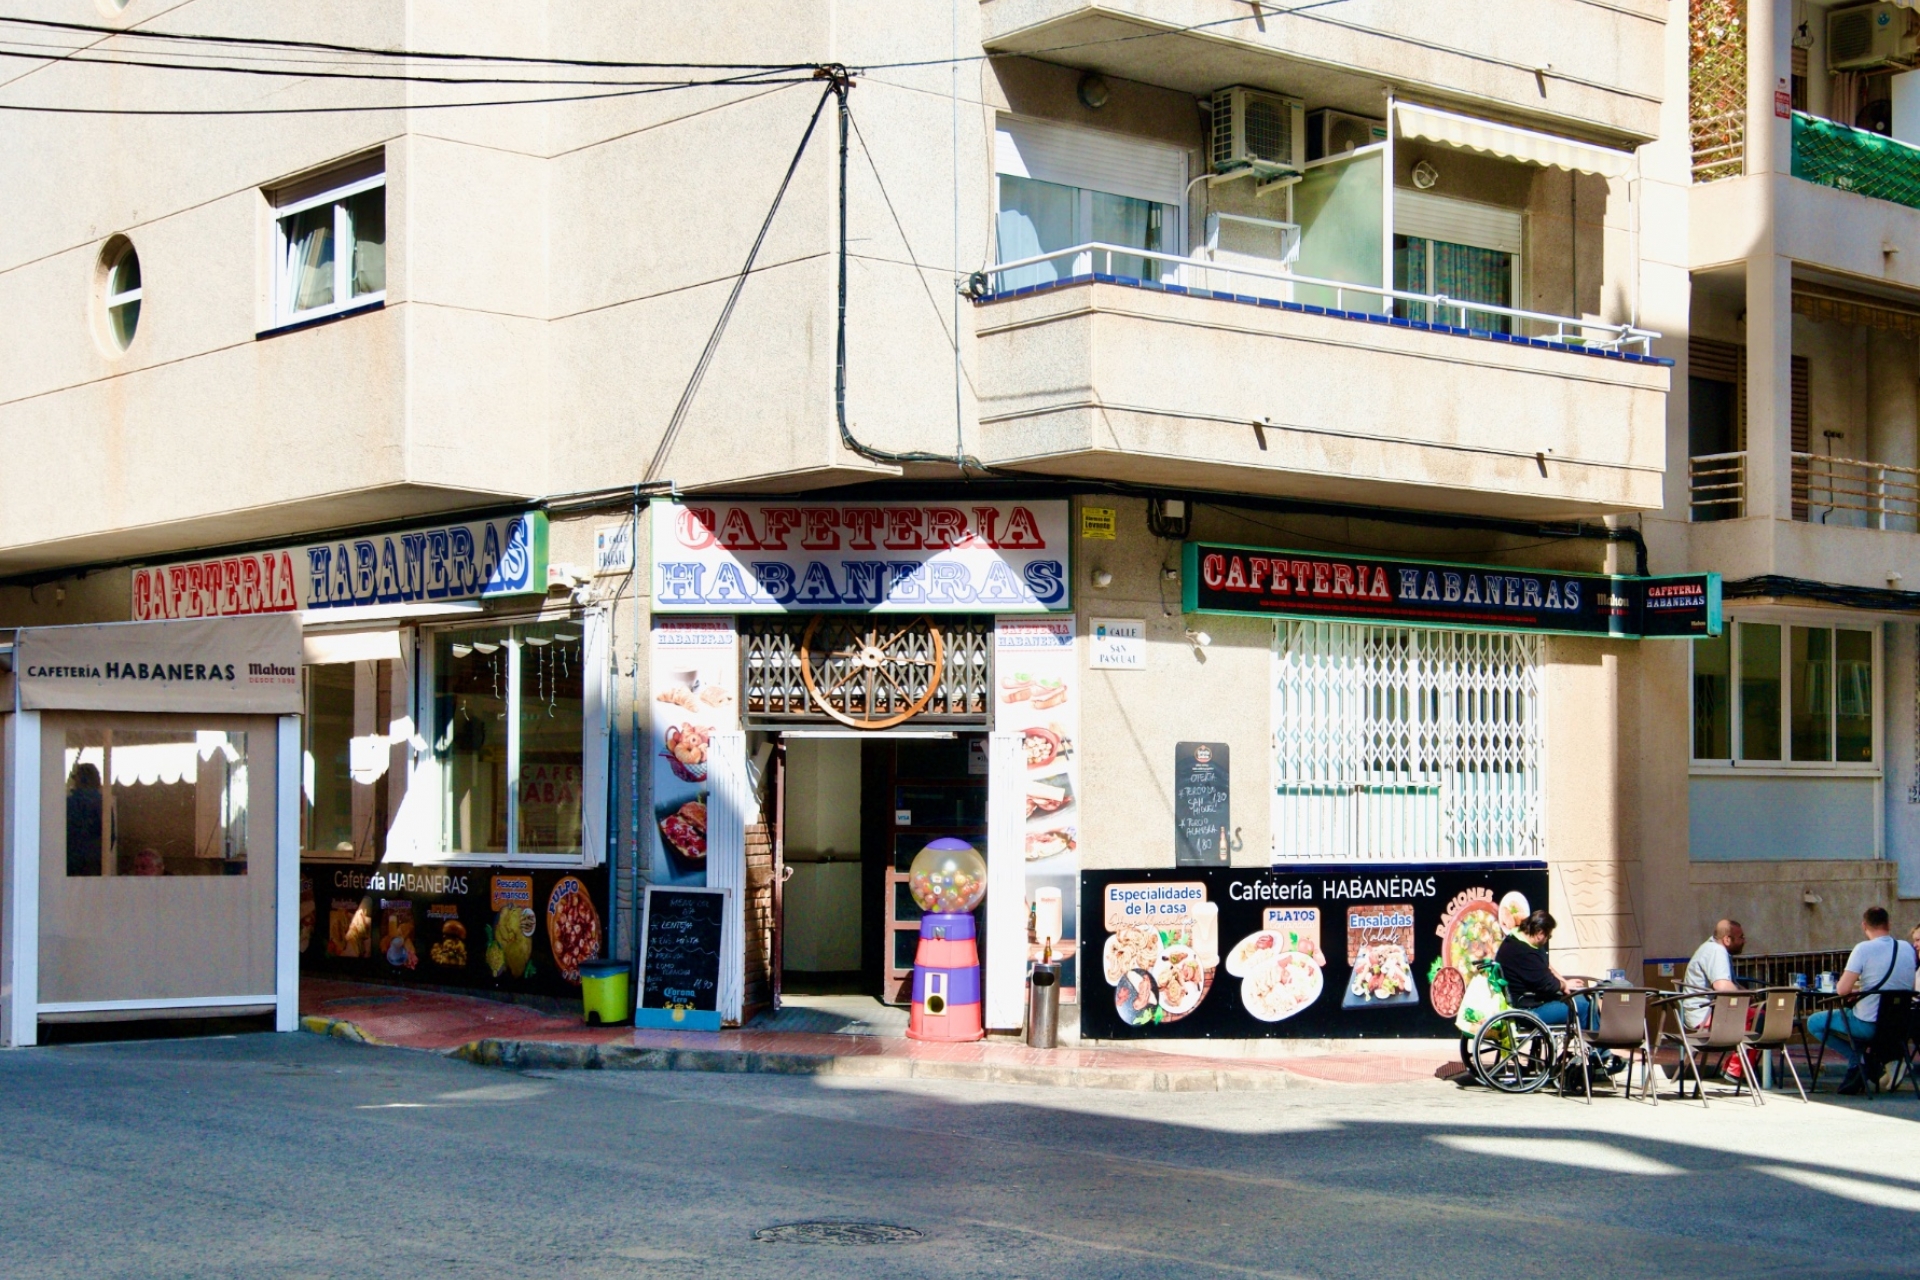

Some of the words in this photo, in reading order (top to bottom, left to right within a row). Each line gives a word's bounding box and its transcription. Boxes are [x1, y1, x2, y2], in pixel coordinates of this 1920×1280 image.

[675, 507, 1046, 550] CAFETERIA
[133, 550, 297, 621] CAFETERIA
[306, 519, 530, 610] HABANERAS
[657, 560, 1064, 605] HABANERAS
[1203, 553, 1393, 602] CAFETERIA
[1398, 567, 1580, 612] HABANERAS
[1648, 584, 1703, 597] CAFETERIA
[1596, 593, 1630, 607] Mahou
[1646, 595, 1705, 608] HABANERAS
[660, 622, 730, 633] CAFETERIA
[1001, 624, 1070, 634] CAFETERIA
[1110, 627, 1137, 637] CALLE
[657, 634, 733, 645] HABANERAS
[998, 636, 1073, 646] HABANERAS
[1110, 643, 1127, 653] SAN
[1100, 654, 1137, 664] PASCUAL
[27, 663, 100, 678] CAFETERÍA
[105, 662, 236, 681] HABANERAS
[248, 662, 296, 676] Mahou
[334, 870, 386, 891] Cafetería
[388, 872, 469, 895] HABANERAS
[496, 879, 528, 889] Pescados
[500, 891, 529, 900] mariscos
[1110, 886, 1202, 903] Especialidades
[1229, 879, 1313, 901] Cafetería
[1322, 878, 1437, 900] HABANERAS
[548, 879, 579, 915] PULPO
[1125, 902, 1142, 915] de
[1145, 902, 1157, 914] la
[1160, 903, 1187, 914] casa
[1435, 886, 1494, 939] RACIONES
[1268, 910, 1316, 922] PLATOS
[1350, 912, 1413, 928] Ensaladas
[663, 986, 697, 998] Corona
